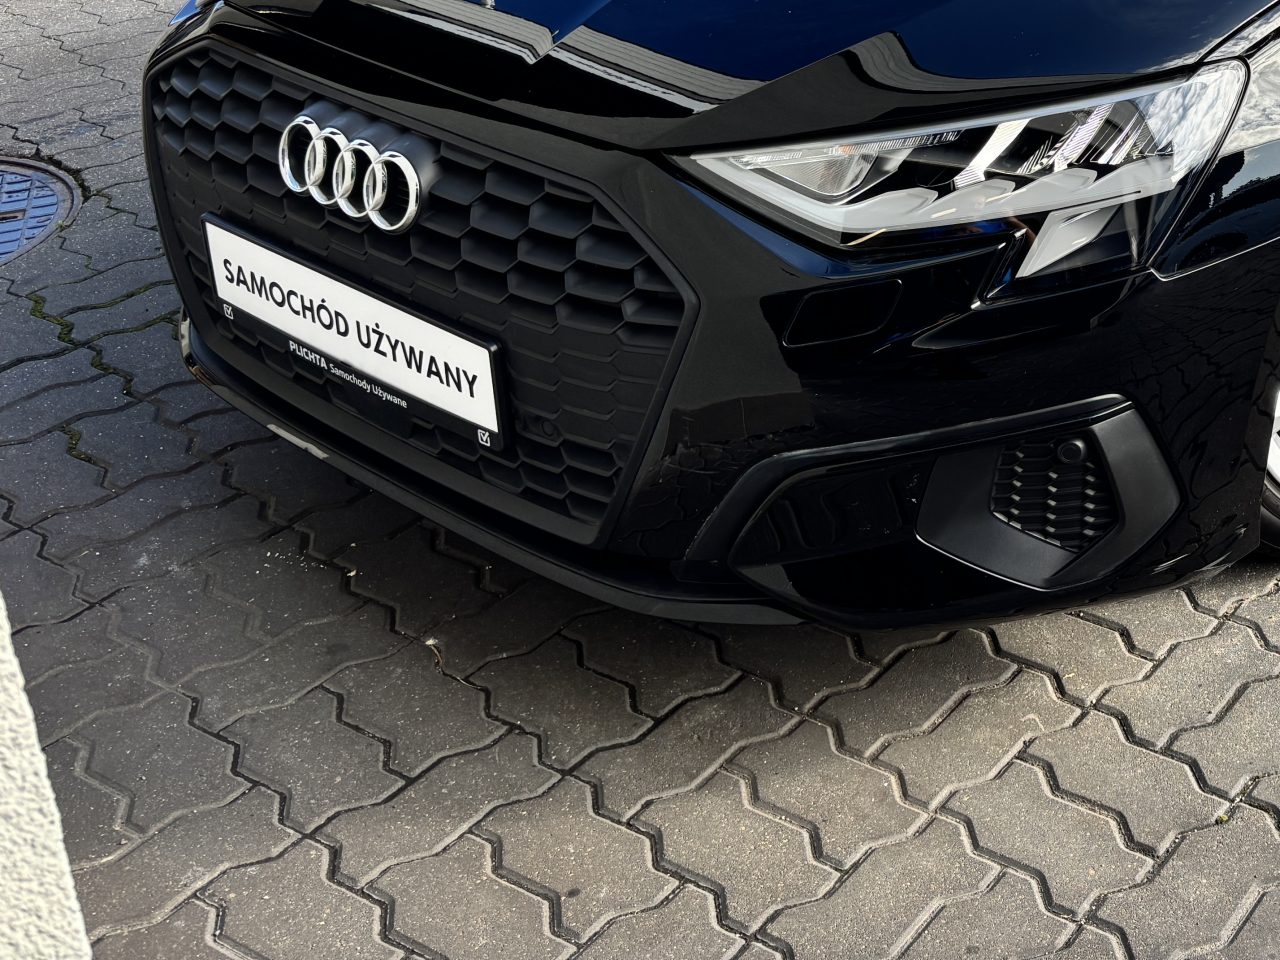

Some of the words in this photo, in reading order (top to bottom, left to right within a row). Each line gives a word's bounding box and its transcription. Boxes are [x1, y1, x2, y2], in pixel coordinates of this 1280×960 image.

[223, 258, 350, 338] SAMOCHÓD
[356, 320, 478, 399] UŻYWANY
[289, 340, 328, 370] PLICHTA
[329, 363, 371, 393] Samochody
[371, 384, 408, 409] Używane
